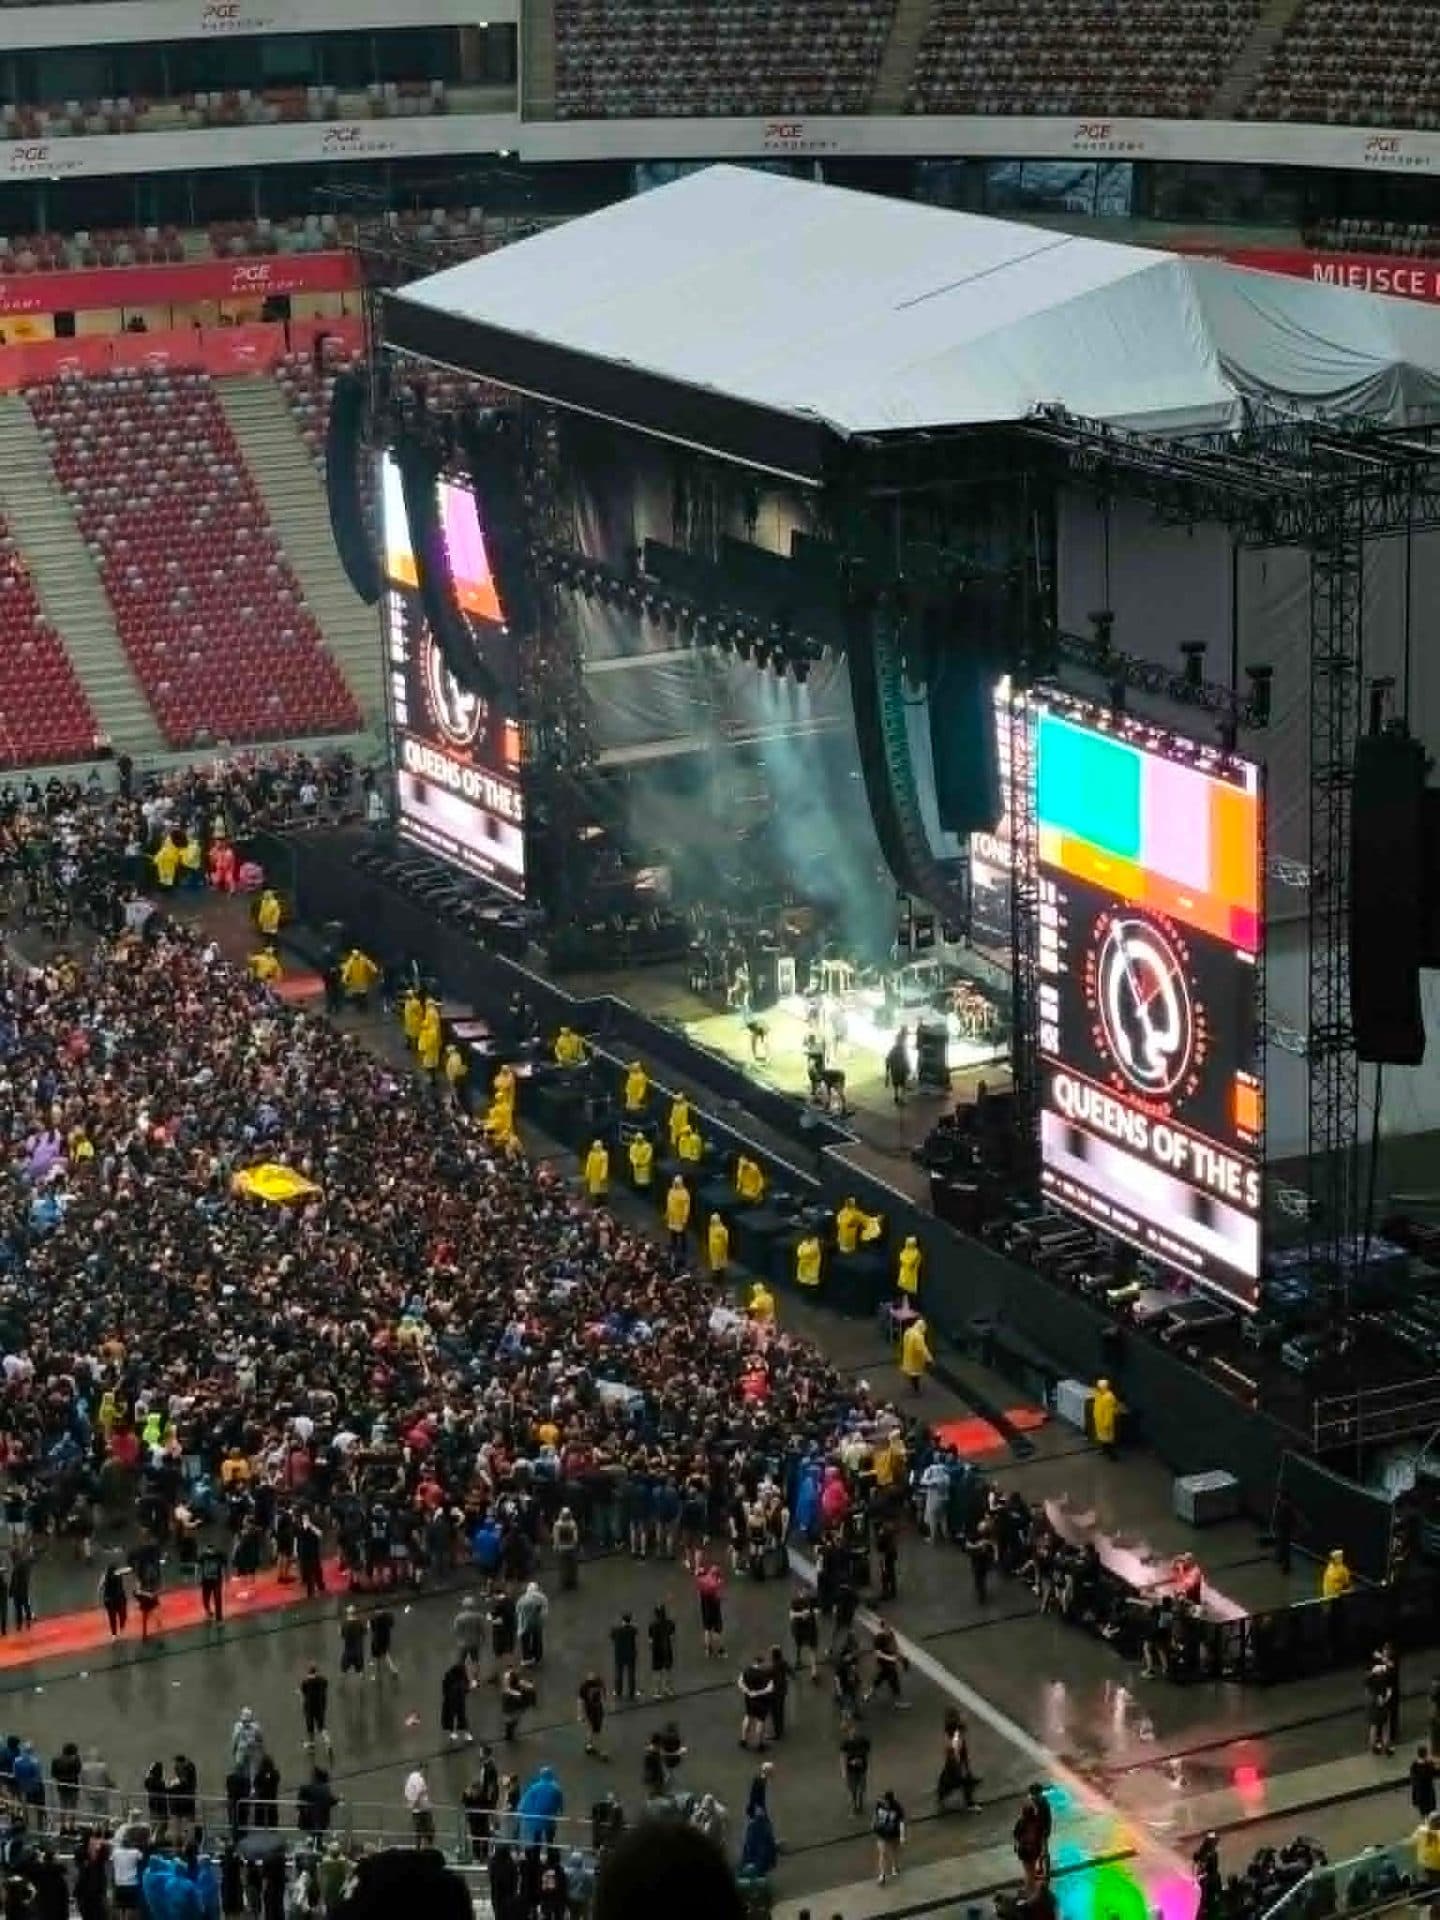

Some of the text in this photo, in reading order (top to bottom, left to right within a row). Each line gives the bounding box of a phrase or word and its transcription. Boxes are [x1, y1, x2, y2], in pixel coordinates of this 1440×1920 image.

[1312, 262, 1426, 295] MIEJSCE
[404, 740, 461, 788] QUEENS
[462, 768, 483, 799] OF
[483, 777, 512, 816] THE
[1053, 1073, 1149, 1150] QUEENS
[1153, 1124, 1189, 1169] OF
[1189, 1139, 1243, 1199] THE
